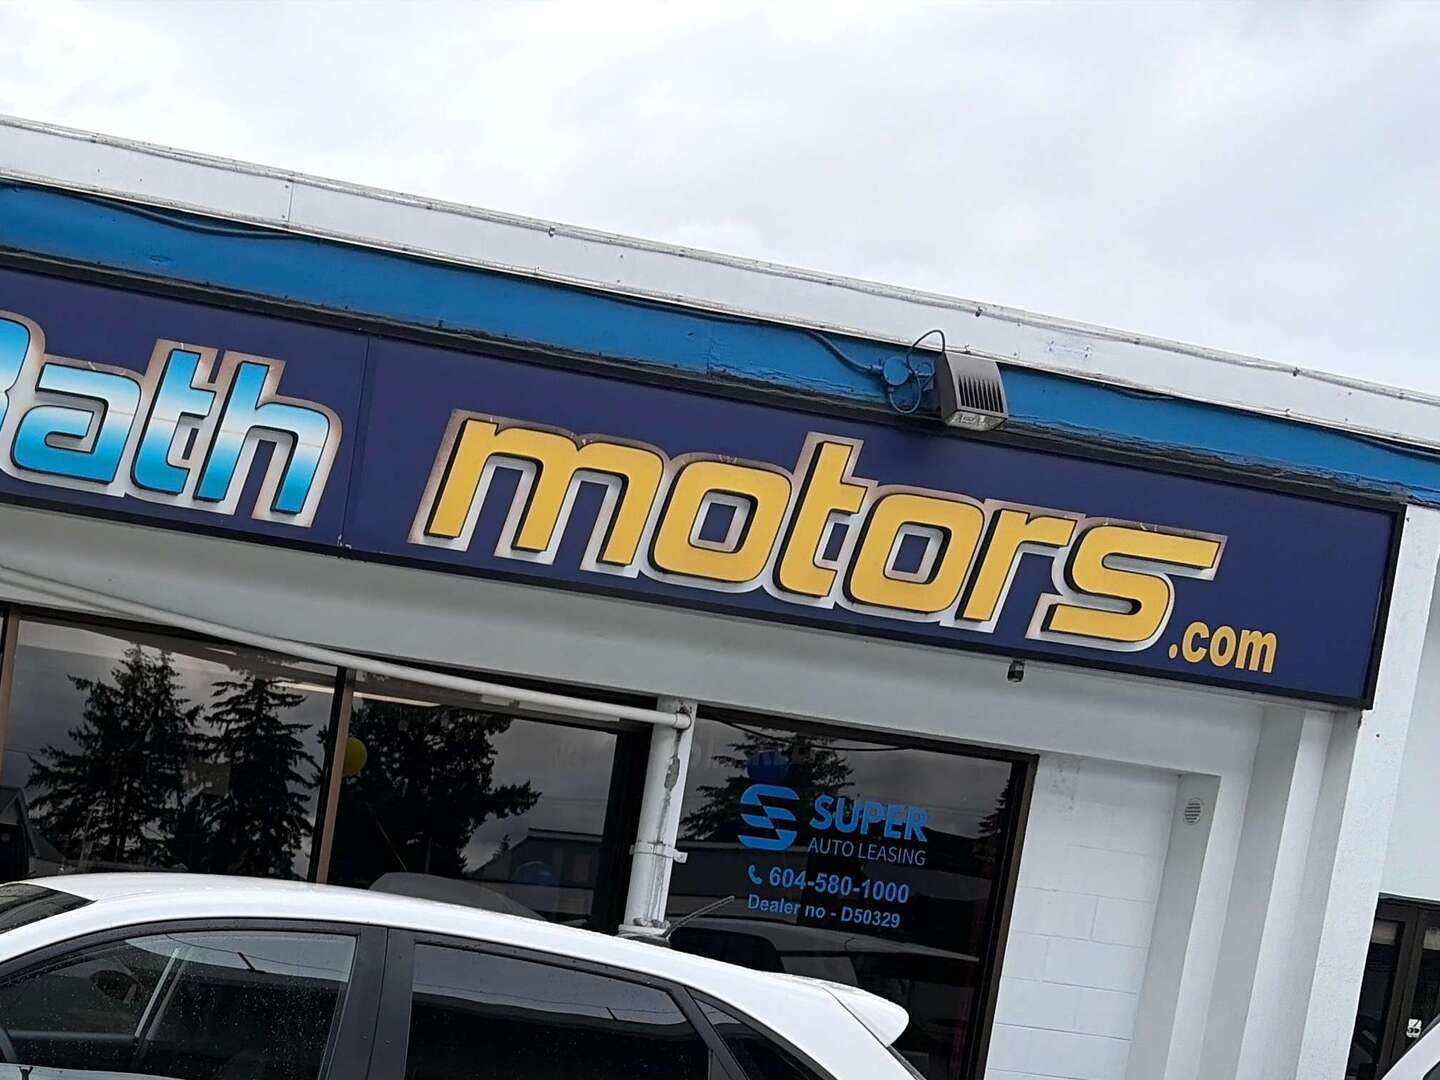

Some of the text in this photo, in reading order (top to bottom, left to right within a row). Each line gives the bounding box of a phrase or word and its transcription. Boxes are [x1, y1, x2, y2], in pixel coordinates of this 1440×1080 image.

[408, 408, 1227, 652] motors
[1168, 621, 1277, 673] .com
[810, 794, 928, 842] SUPER
[808, 837, 927, 866] AUTO LEASING
[769, 867, 910, 904] 604-580-1000
[747, 894, 800, 915] Dealer
[805, 904, 826, 918] no
[841, 906, 901, 928] D50329
